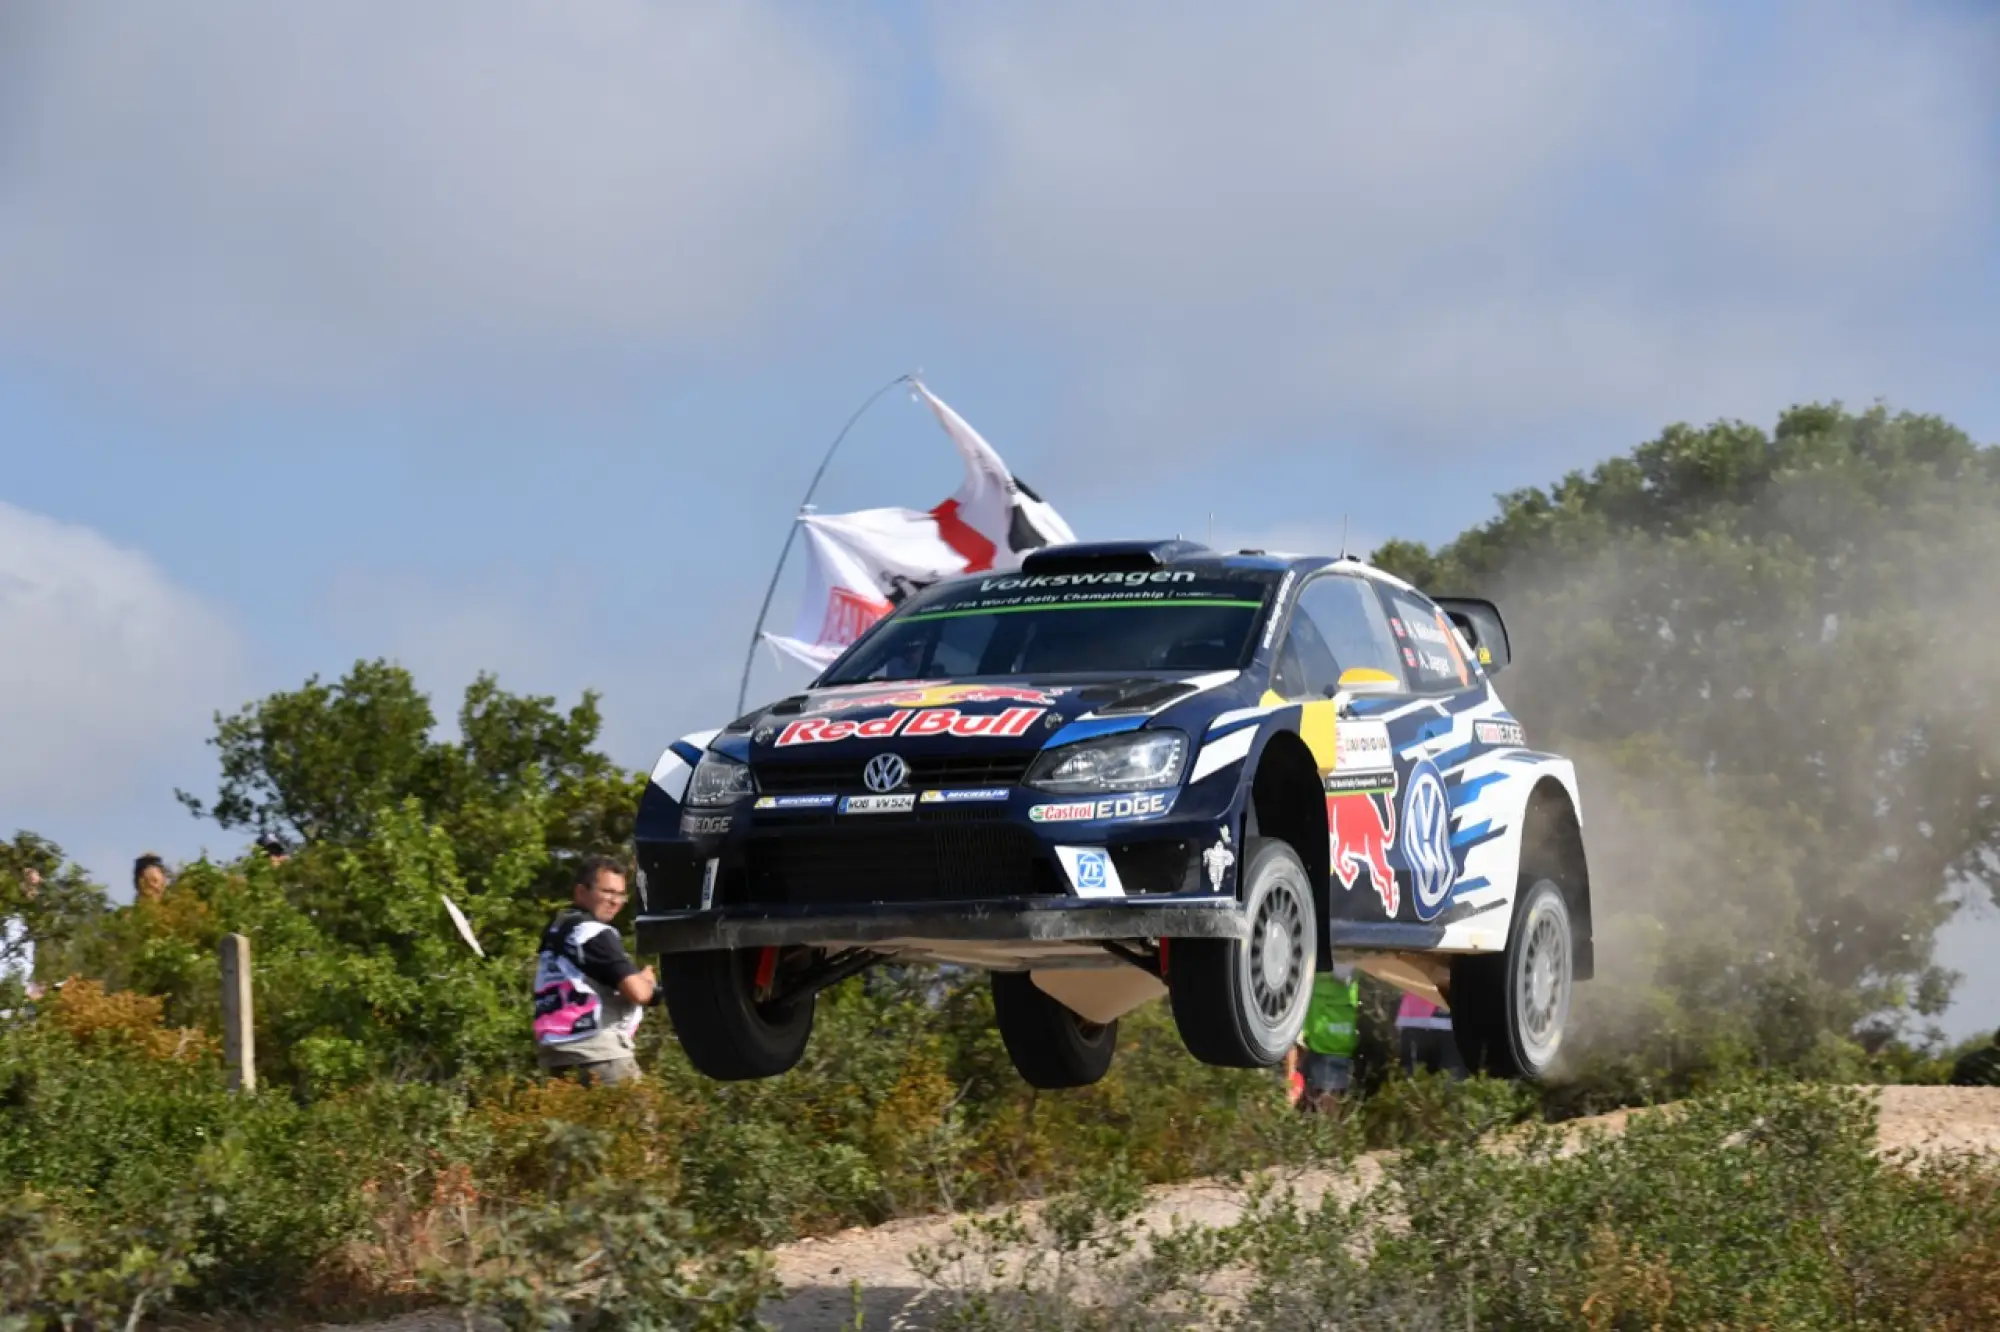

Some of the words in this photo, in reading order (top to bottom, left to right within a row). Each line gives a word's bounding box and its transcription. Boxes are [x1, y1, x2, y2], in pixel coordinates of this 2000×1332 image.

[980, 571, 1196, 593] Volkswagen
[981, 597, 1022, 607] World
[1024, 594, 1060, 604] Rally
[1063, 590, 1165, 601] Championship
[775, 709, 915, 747] Red
[901, 707, 1047, 737] Bull
[848, 798, 869, 809] WOB
[1043, 803, 1093, 820] Castrol
[1096, 794, 1165, 819] EDGE
[693, 815, 732, 833] EDGE
